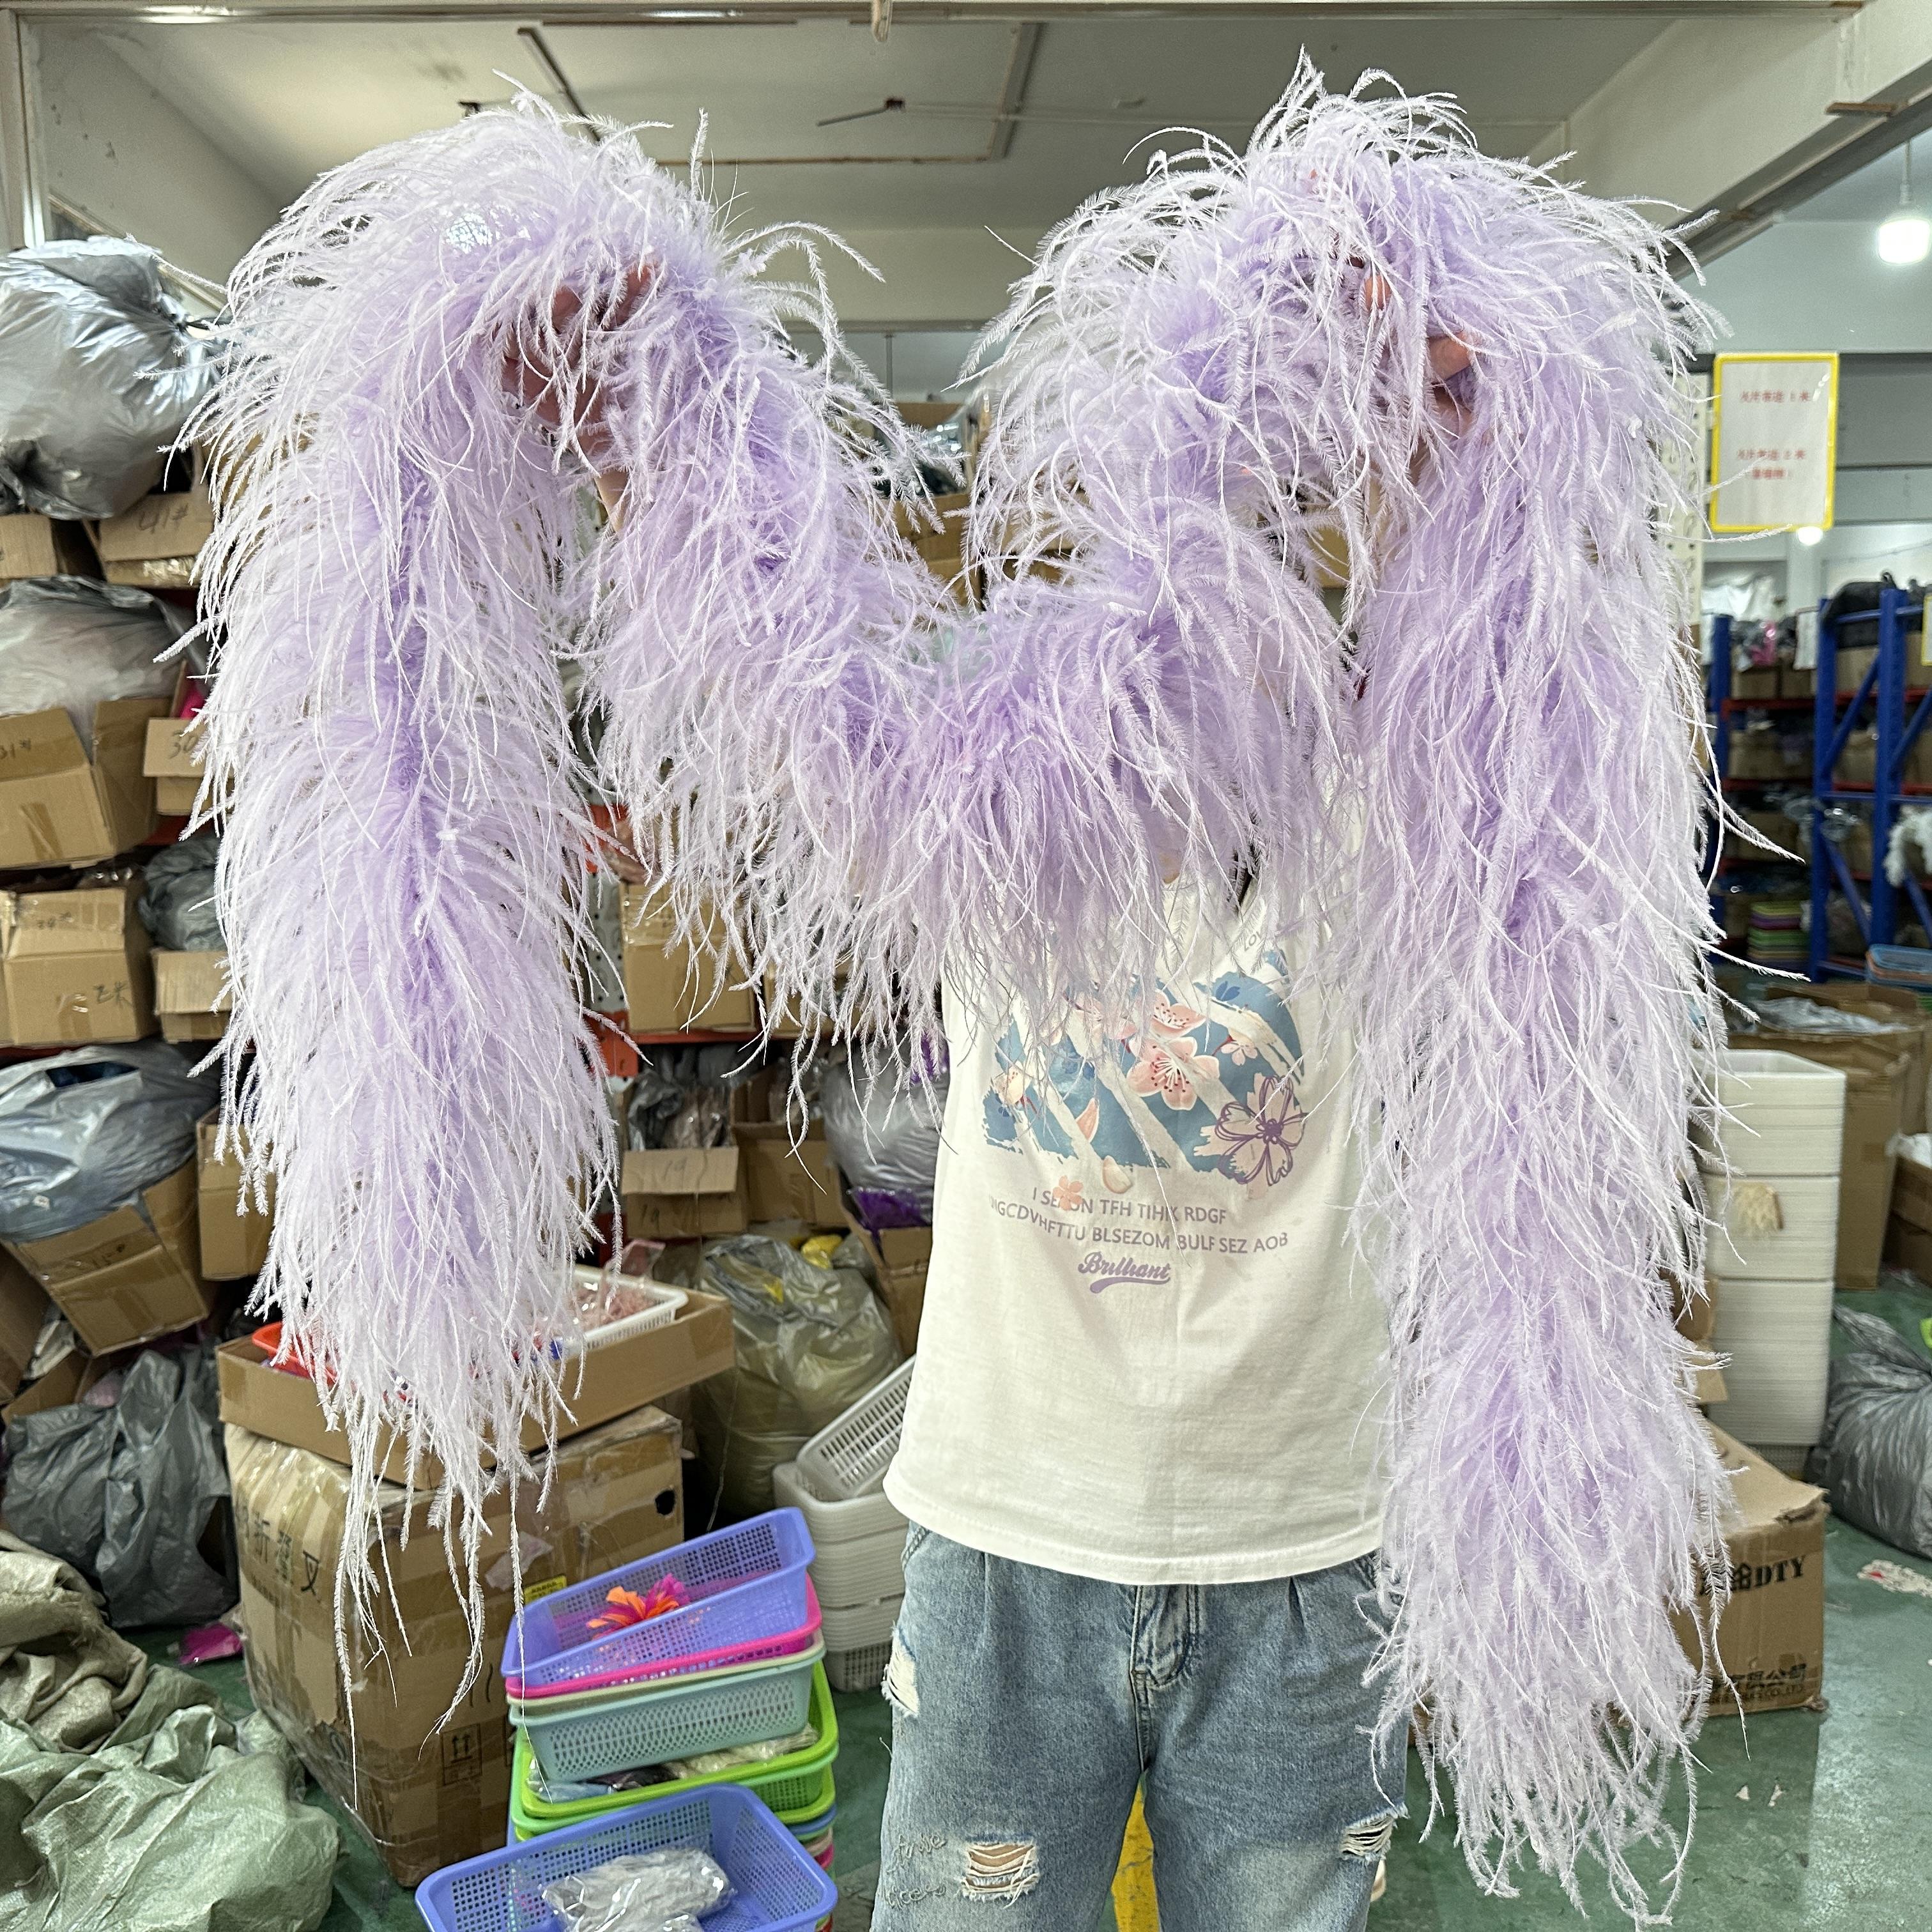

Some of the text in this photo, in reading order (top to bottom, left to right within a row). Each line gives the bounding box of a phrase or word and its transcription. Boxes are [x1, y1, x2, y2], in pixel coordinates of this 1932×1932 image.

[1032, 1187, 1037, 1200] I
[1100, 1199, 1131, 1216] TFH
[1184, 1206, 1227, 1225] RDGF
[1092, 1227, 1170, 1250] BLSEZOM
[1218, 1238, 1248, 1254] SEZ
[1253, 1232, 1288, 1253] AOB
